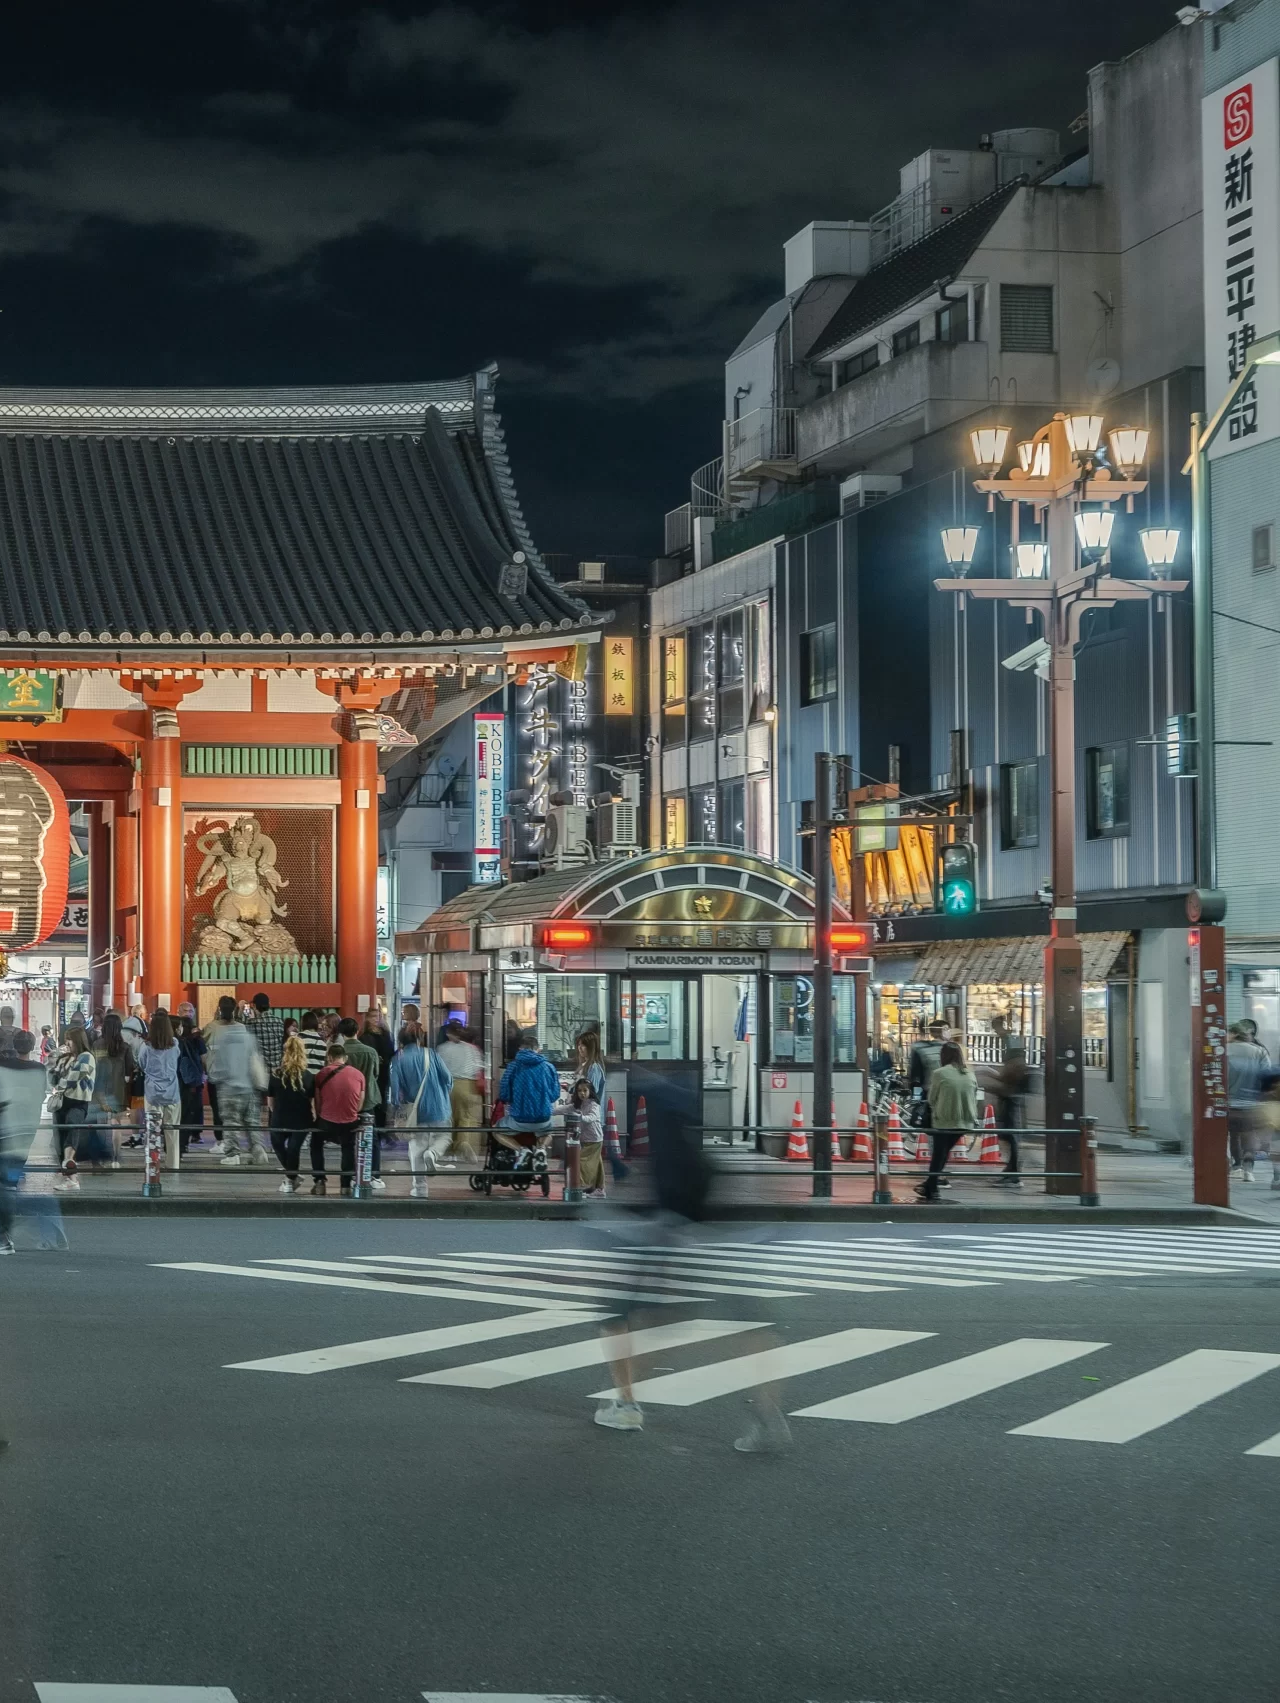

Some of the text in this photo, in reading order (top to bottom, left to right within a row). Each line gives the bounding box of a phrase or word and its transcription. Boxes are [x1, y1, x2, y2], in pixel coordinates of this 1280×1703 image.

[1224, 147, 1258, 441] 新三平建設
[611, 642, 626, 706] 鉄板焼
[490, 723, 502, 781] KOBE
[635, 955, 756, 966] KAMINARIMON KOBAN
[697, 928, 773, 947] 雷門交番
